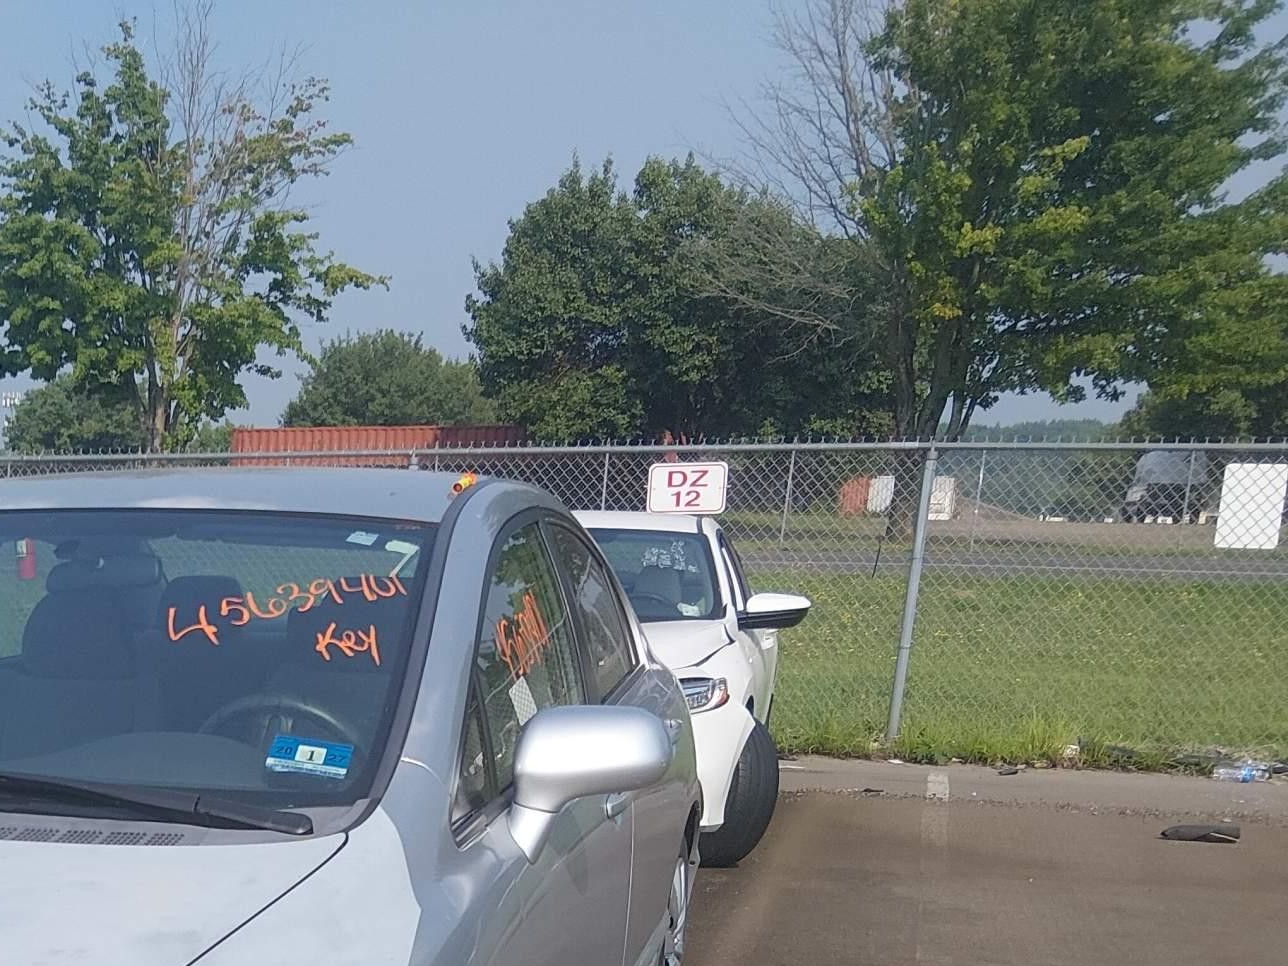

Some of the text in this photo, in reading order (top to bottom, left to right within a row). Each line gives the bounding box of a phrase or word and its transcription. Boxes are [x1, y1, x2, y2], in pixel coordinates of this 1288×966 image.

[667, 469, 709, 488] DZ
[670, 490, 701, 507] 12
[167, 573, 407, 646] 45639401
[275, 746, 293, 755] 20
[306, 750, 316, 761] 1
